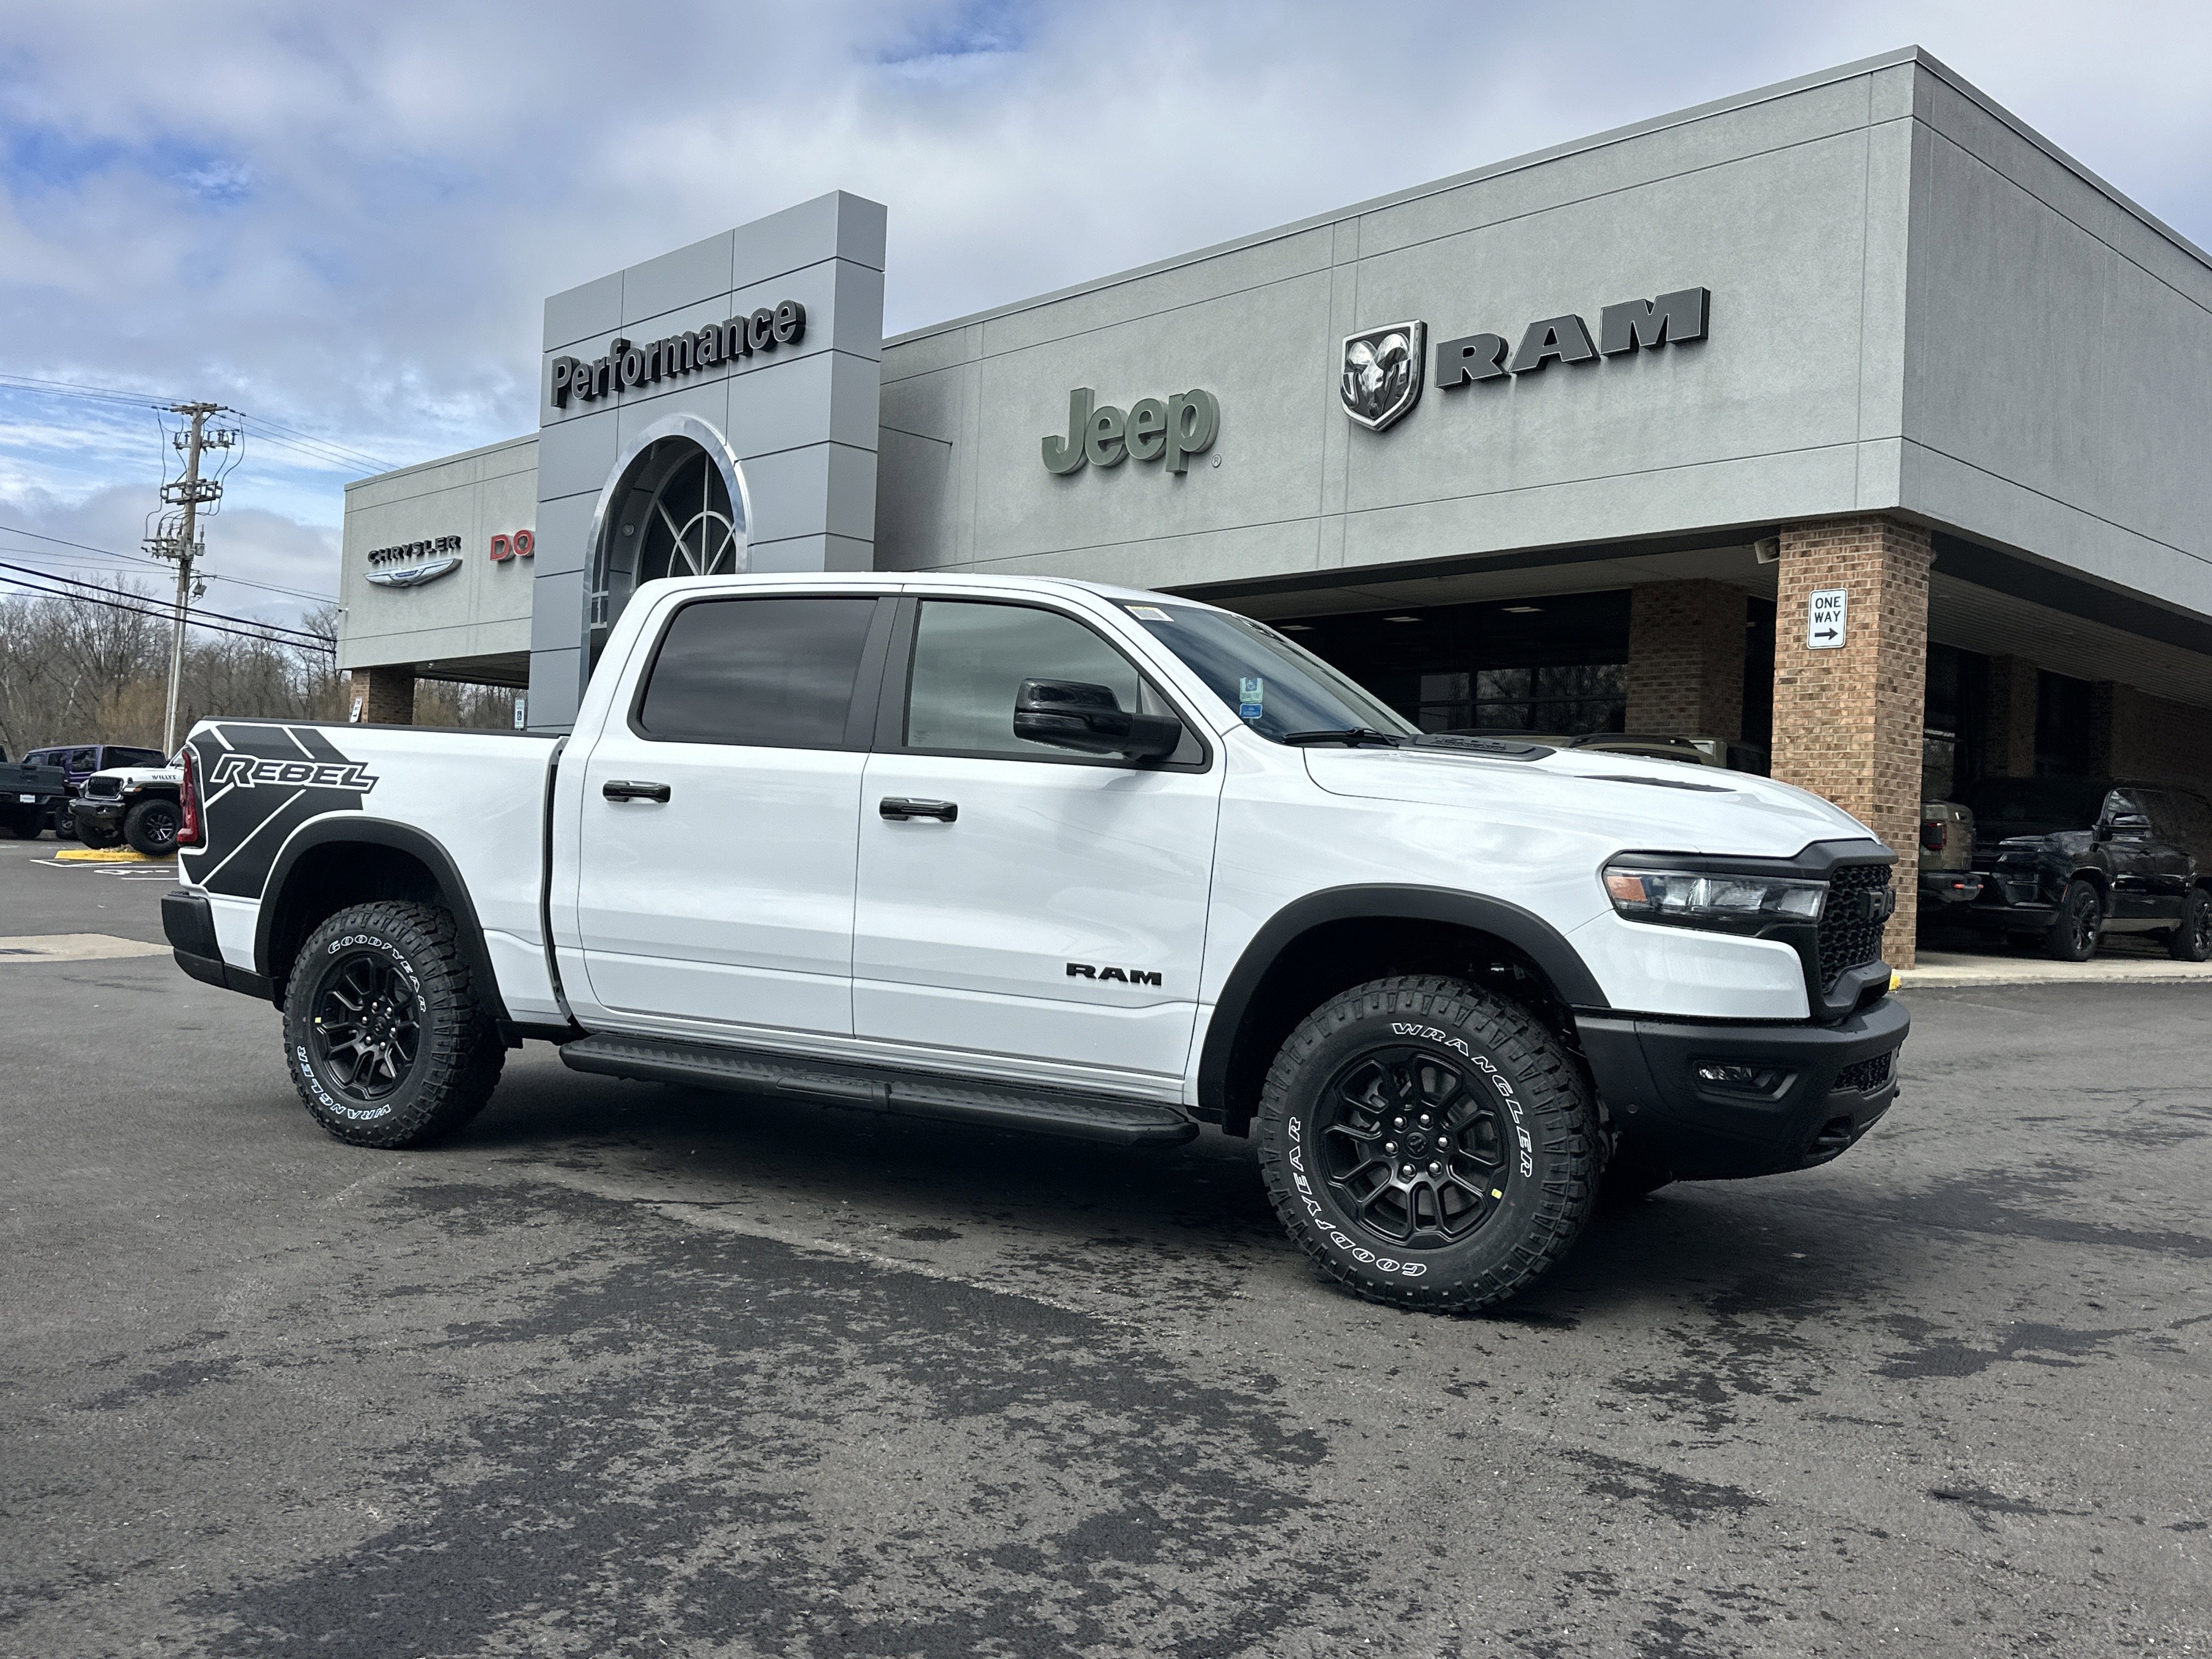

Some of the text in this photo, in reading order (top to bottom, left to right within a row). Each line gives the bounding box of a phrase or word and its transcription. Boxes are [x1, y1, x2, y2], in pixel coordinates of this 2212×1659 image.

[551, 300, 806, 408] Performance
[1435, 287, 1711, 388] RAM
[1042, 387, 1220, 473] Jeep
[368, 535, 461, 563] CHRYSLER
[1814, 611, 1841, 623] WAY
[1815, 596, 1841, 609] ONE
[210, 753, 380, 794] REBEL
[328, 934, 426, 1013] GOODYEAR
[1066, 962, 1161, 986] RAM
[297, 1046, 391, 1120] WRANGLER
[1392, 1023, 1533, 1177] WRANGLER
[1288, 1116, 1427, 1276] GOODYEAR
